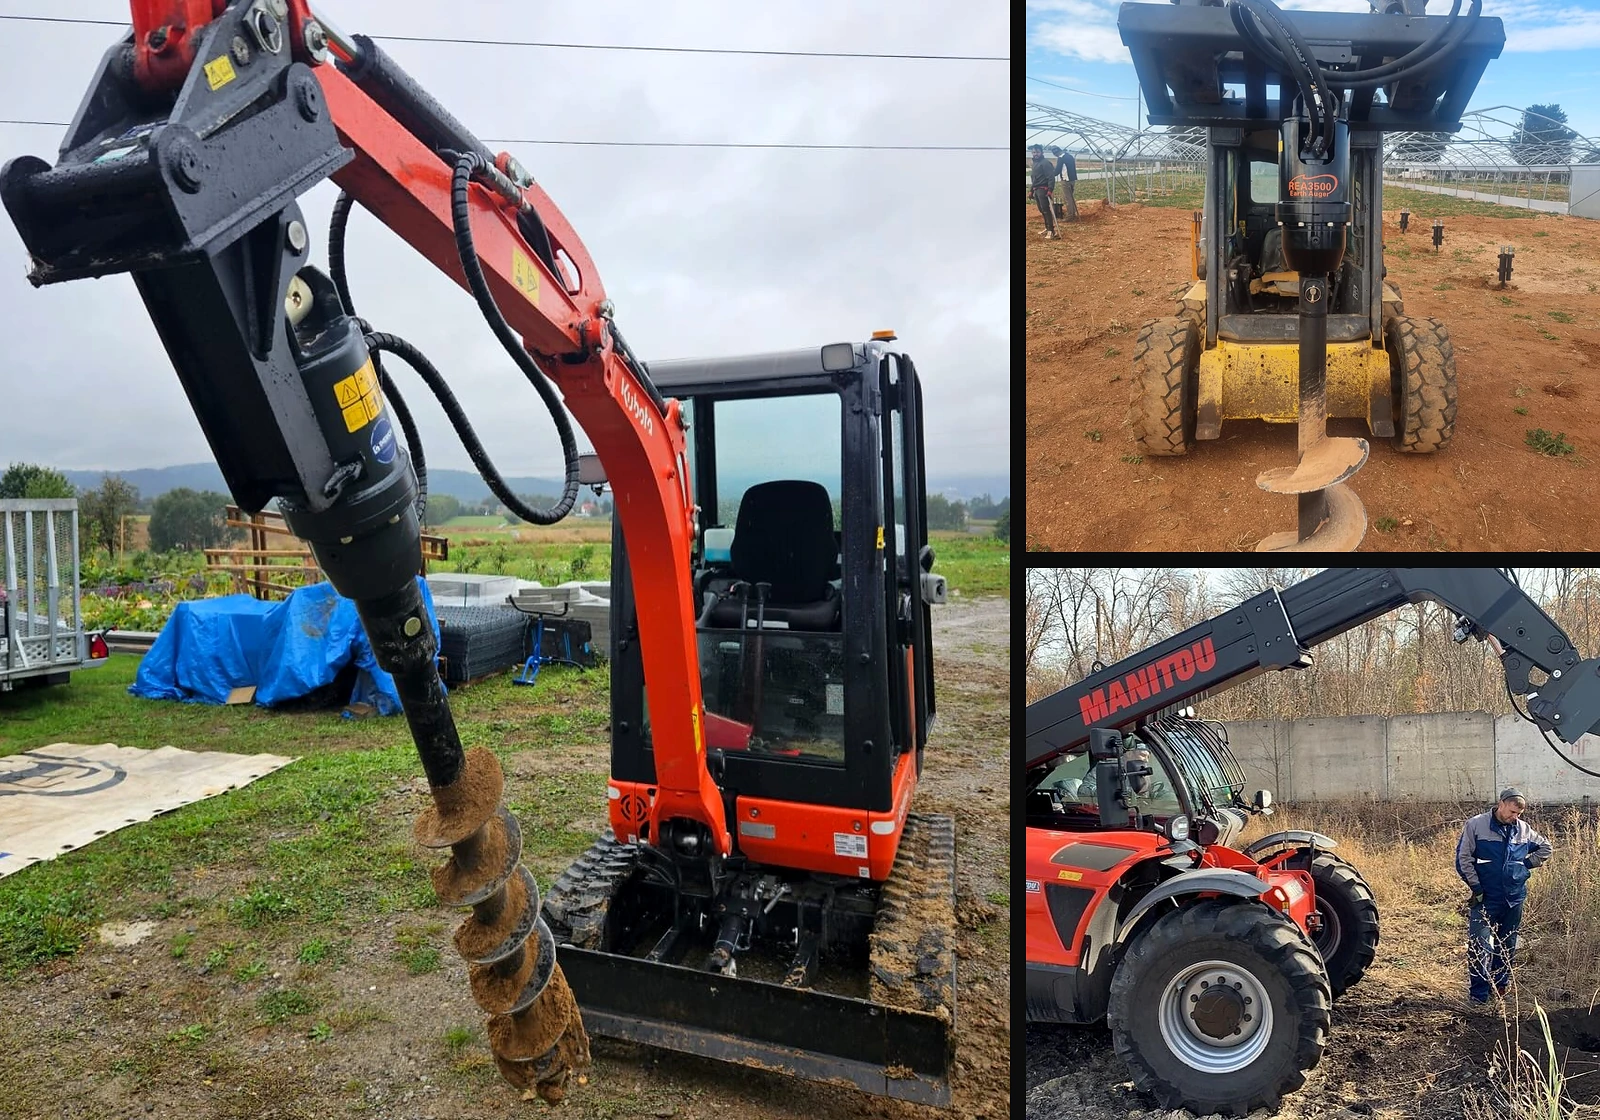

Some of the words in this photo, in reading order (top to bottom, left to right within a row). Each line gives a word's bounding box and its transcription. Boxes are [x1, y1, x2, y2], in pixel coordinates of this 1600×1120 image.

[1288, 181, 1332, 191] REA3500
[1308, 190, 1329, 198] Auger
[621, 376, 653, 436] Kubota
[1078, 637, 1217, 726] MANITOU
